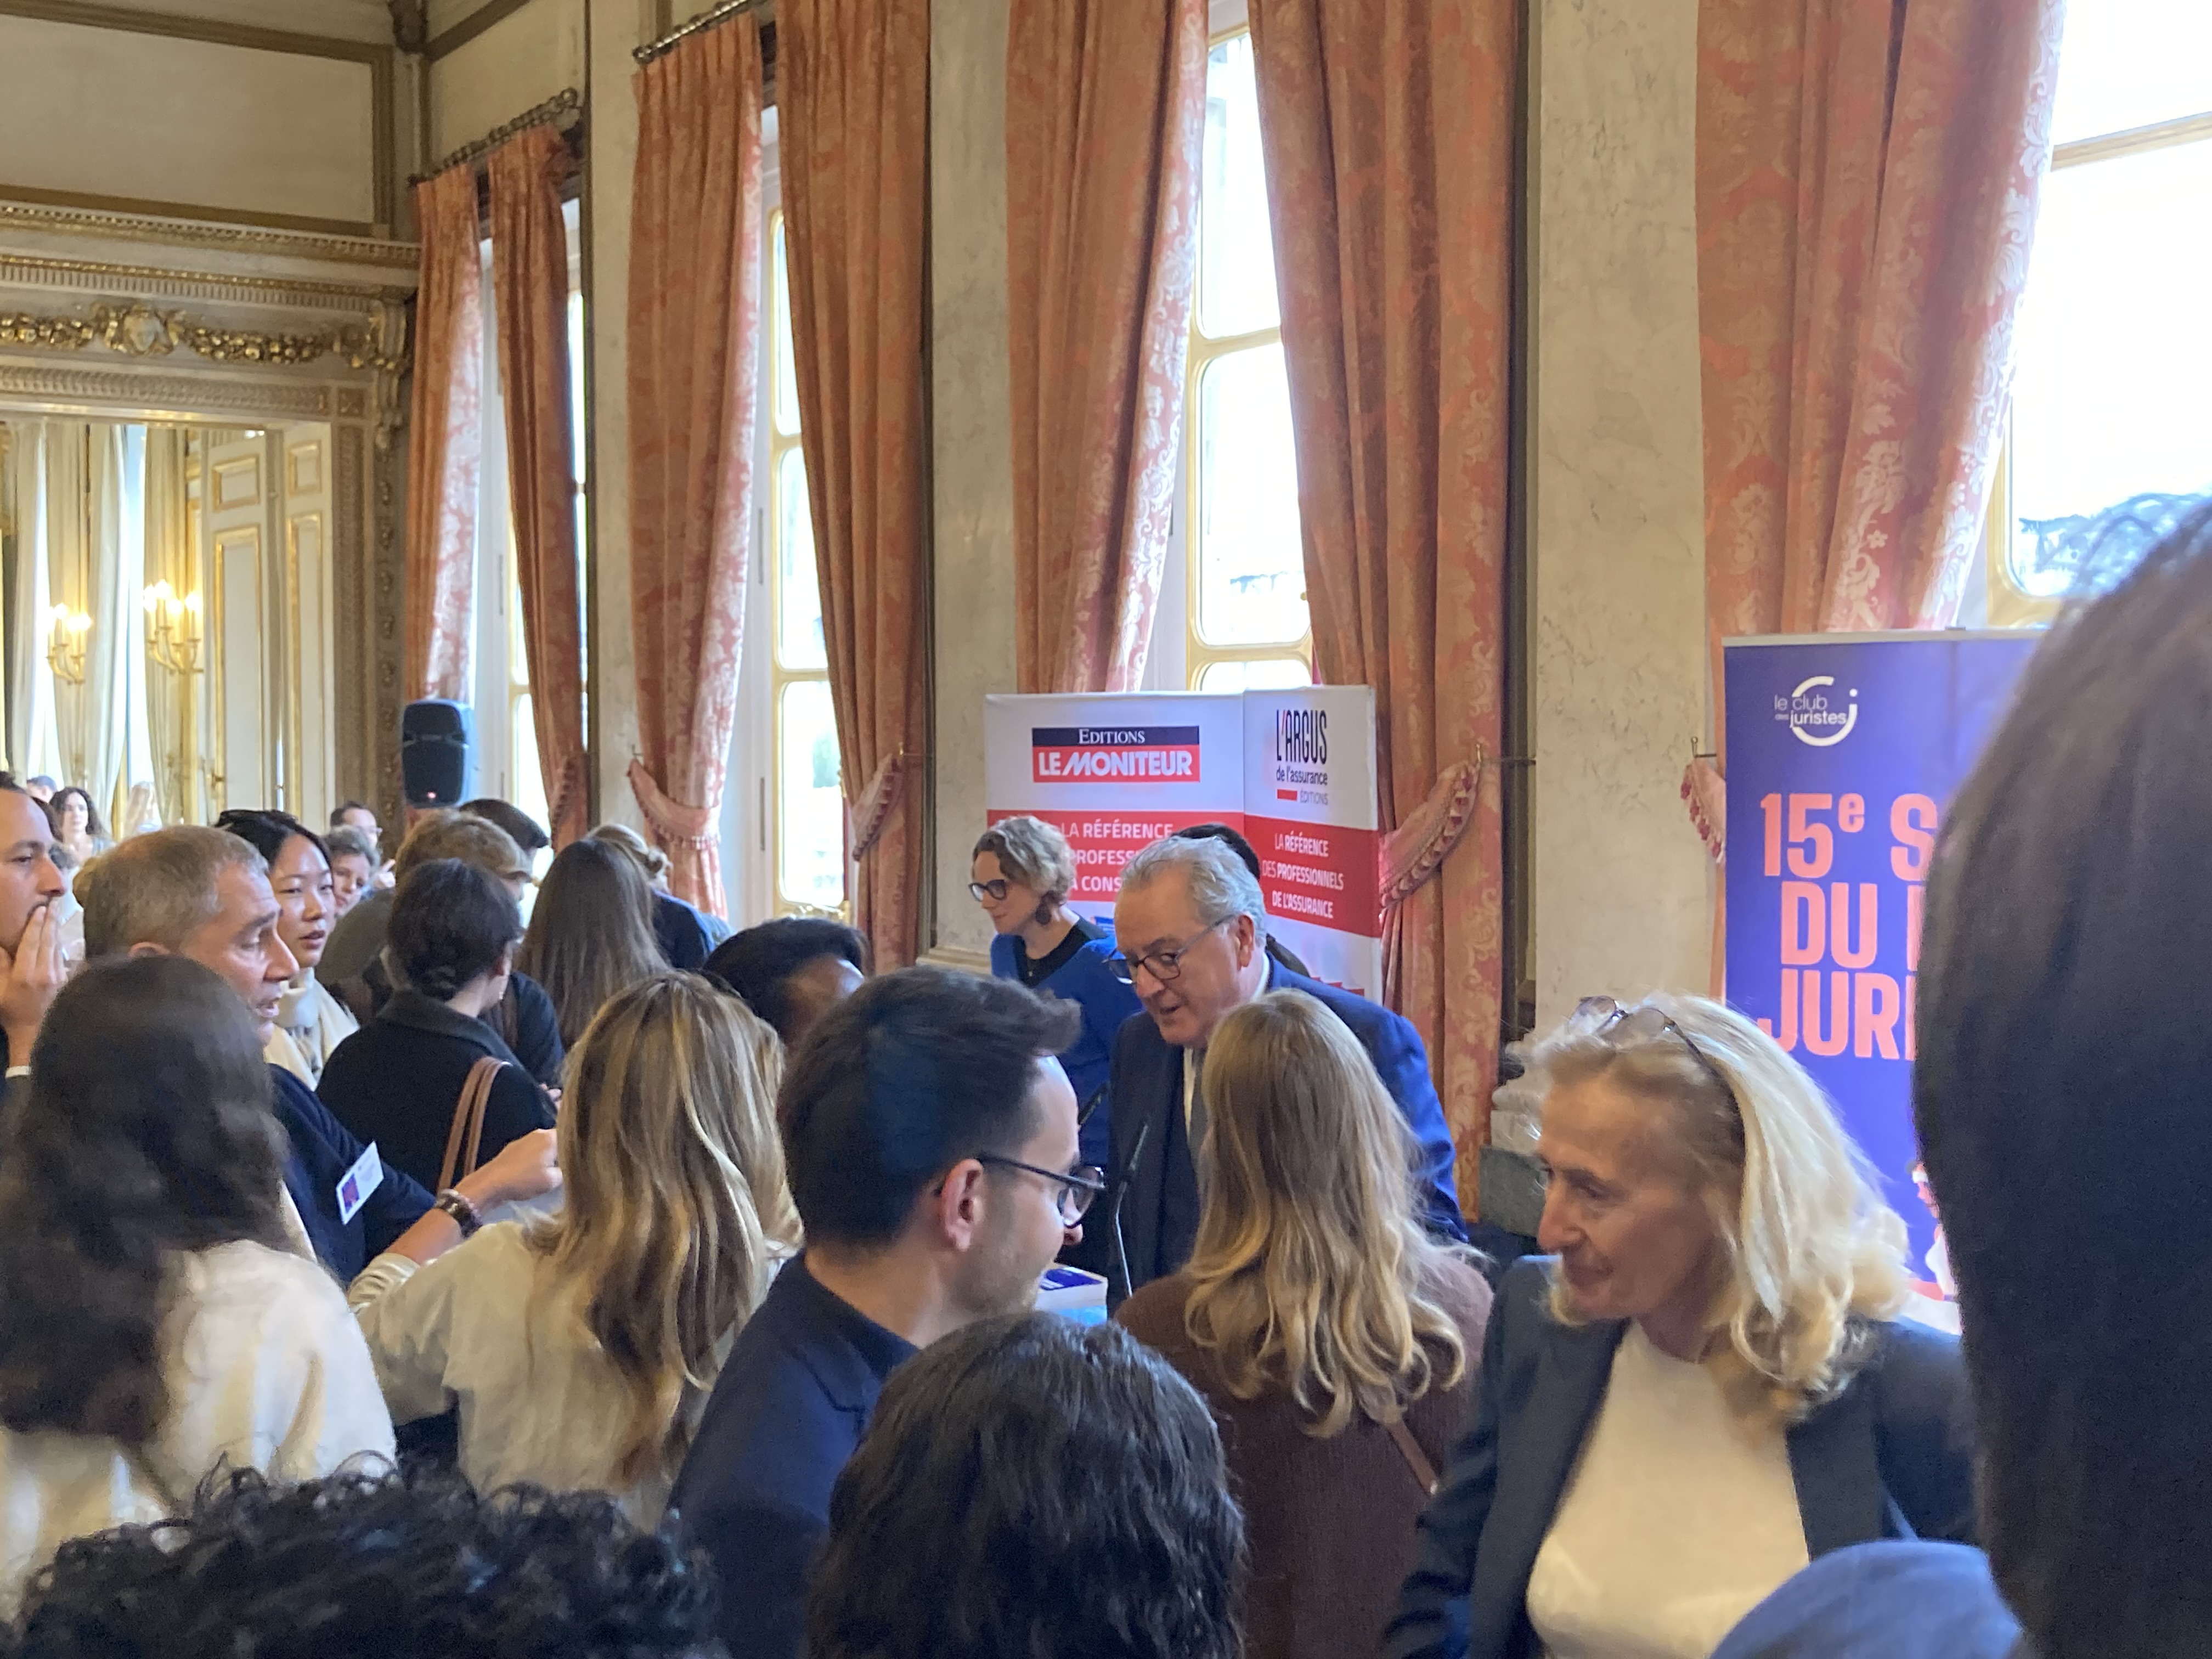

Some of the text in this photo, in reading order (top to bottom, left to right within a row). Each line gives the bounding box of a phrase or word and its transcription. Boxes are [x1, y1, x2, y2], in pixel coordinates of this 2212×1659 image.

[1774, 693, 1827, 710] le club
[1790, 710, 1847, 728] juristes
[1277, 709, 1327, 765] L'ARGUS
[1039, 751, 1192, 776] LE MONITEUR
[1276, 765, 1328, 786] de l'assurance
[1061, 818, 1173, 839] LA RÉFÉRENCE
[1274, 830, 1329, 857] LA RÉFÉRENCE
[1262, 860, 1345, 890] DES PROFESSIONNELS
[1272, 890, 1334, 918] DE L'ASSURANCE
[1780, 881, 1878, 968] DU
